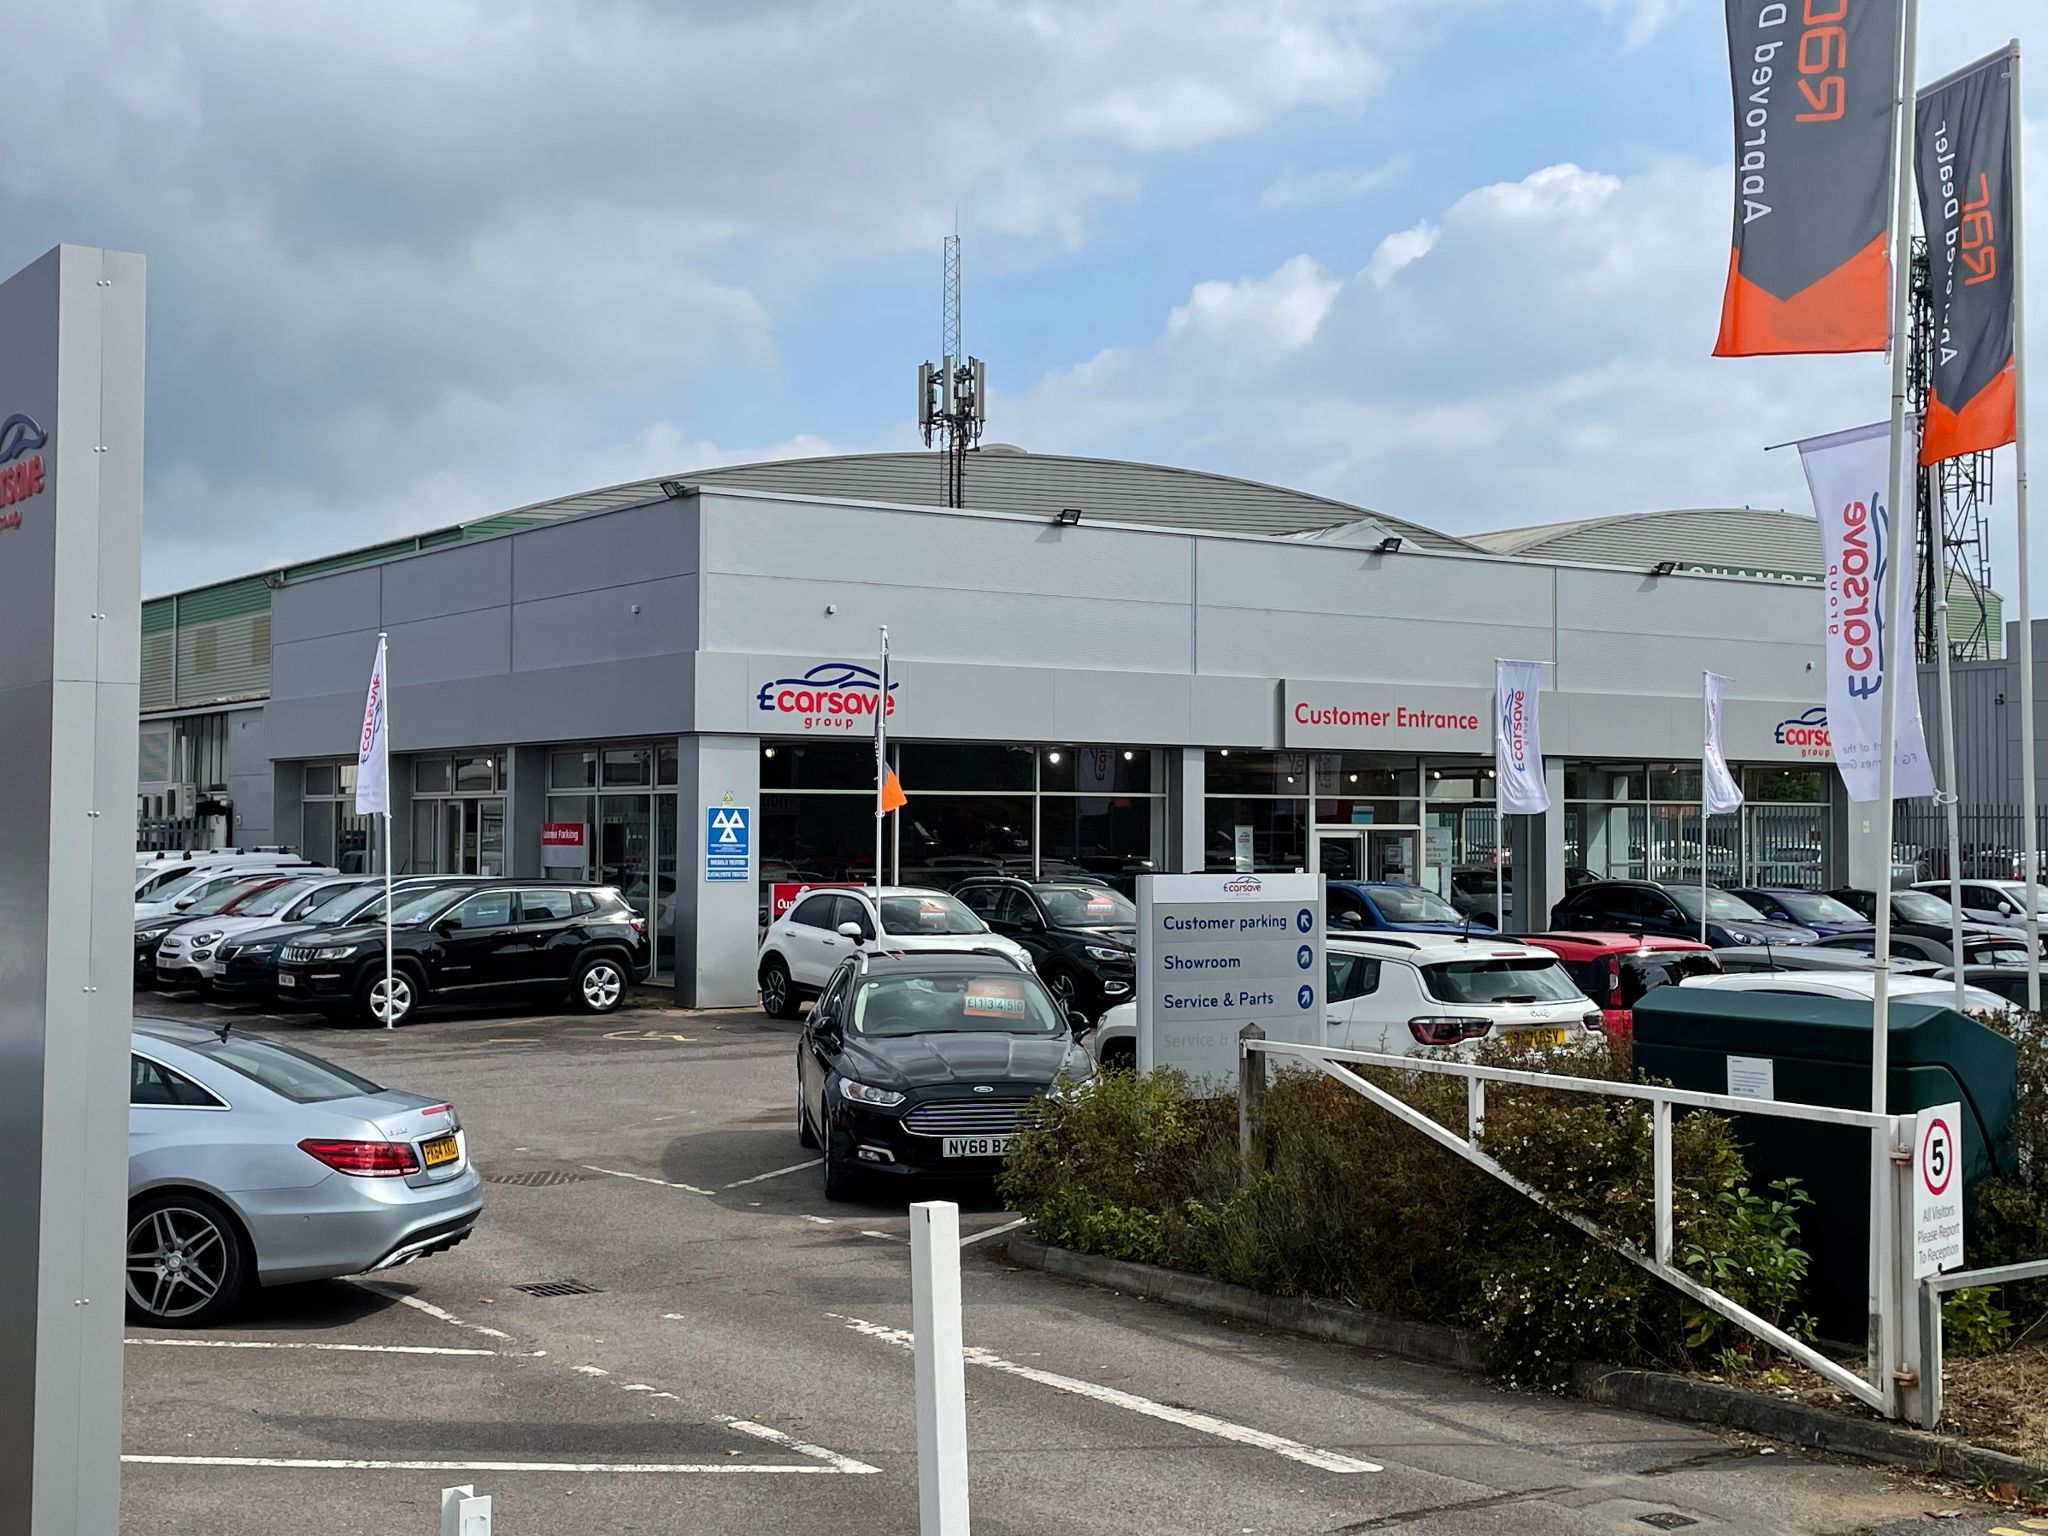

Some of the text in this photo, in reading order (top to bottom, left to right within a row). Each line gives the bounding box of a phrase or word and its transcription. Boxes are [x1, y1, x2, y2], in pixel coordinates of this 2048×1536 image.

[804, 717, 854, 730] group
[1294, 702, 1479, 730] Customer Entrance
[1801, 748, 1832, 758] group
[1163, 914, 1287, 932] Customer parking
[1163, 955, 1241, 970] Showroom
[1163, 991, 1274, 1009] Service & Parts
[1163, 1033, 1219, 1049] Service
[949, 1139, 1010, 1154] NV68 BZ
[1932, 1138, 1944, 1177] 5
[1922, 1204, 1956, 1223] All Visitors
[1917, 1222, 1960, 1245] Please Report
[1918, 1243, 1960, 1265] To Reception
